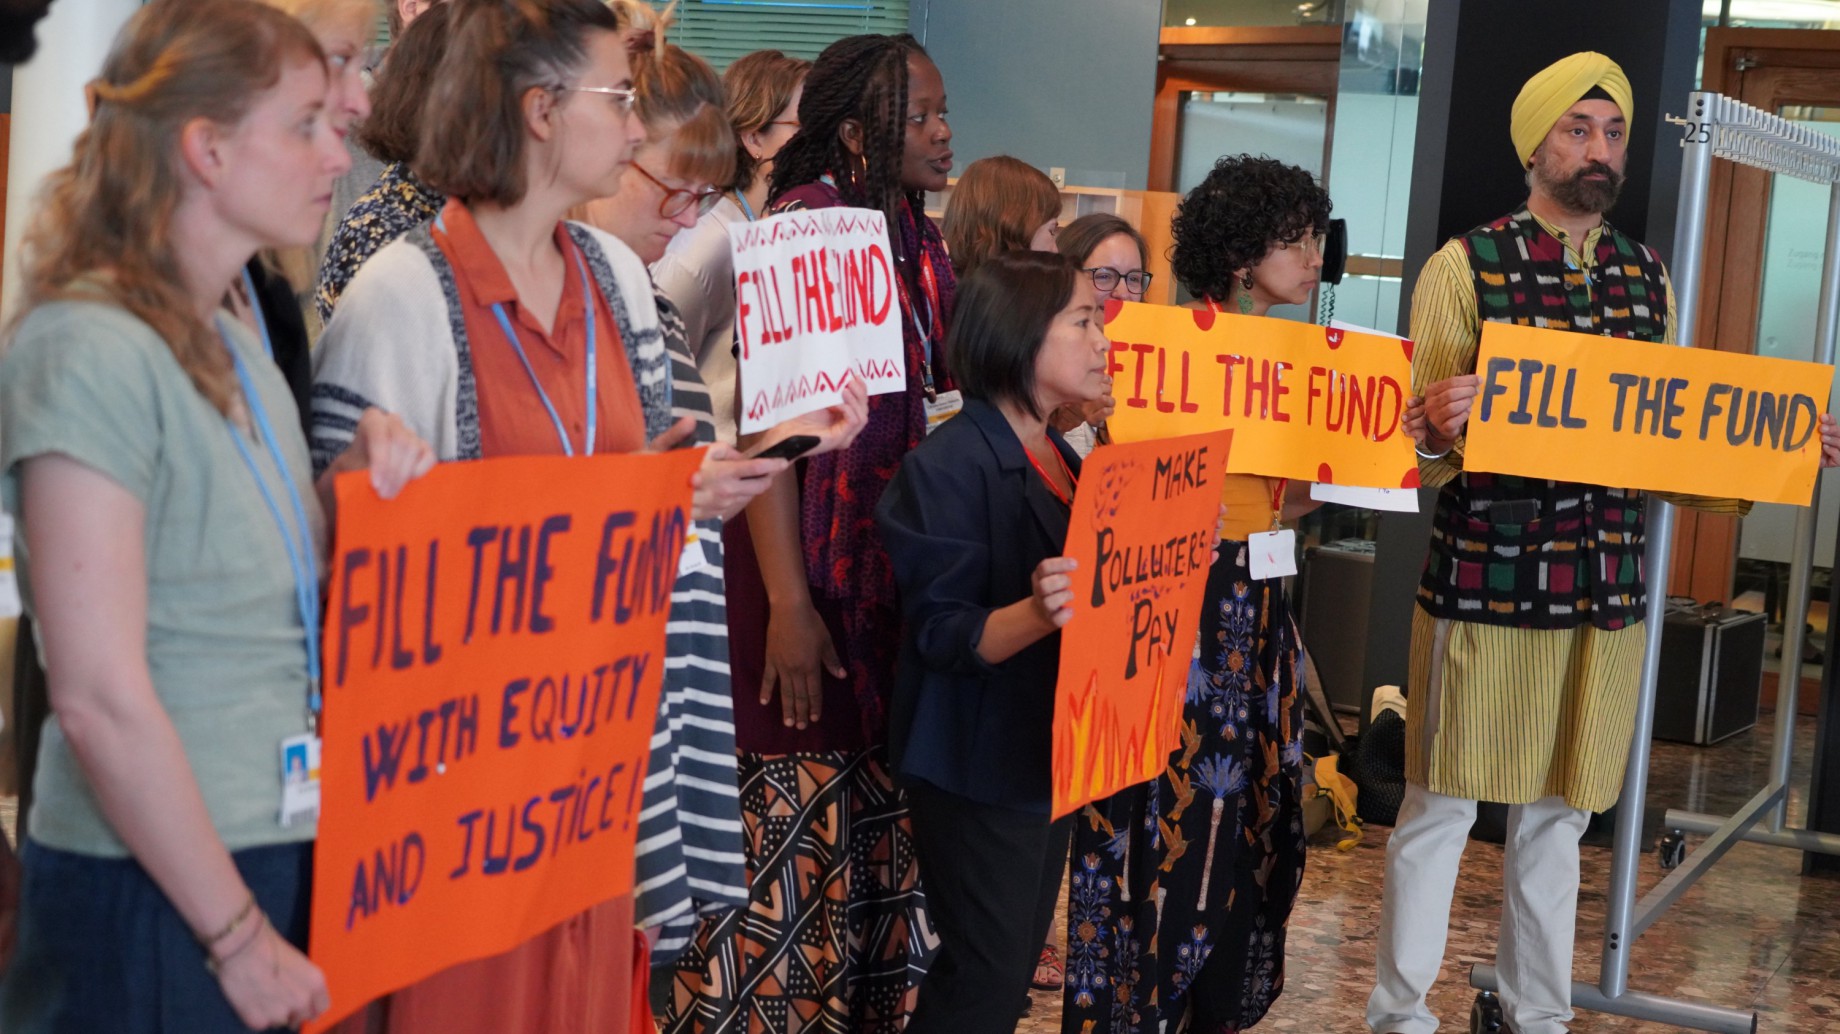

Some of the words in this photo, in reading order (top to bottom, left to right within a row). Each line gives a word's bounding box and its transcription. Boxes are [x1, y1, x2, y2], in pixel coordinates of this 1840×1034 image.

[1685, 122, 1711, 144] 25
[739, 264, 792, 360] FILL
[792, 246, 843, 334] THE
[1107, 340, 1199, 414] FILL
[1216, 353, 1293, 423] THE
[1307, 366, 1403, 443] FUND
[1480, 356, 1587, 429] FILL
[1609, 372, 1689, 440] THE
[1699, 382, 1818, 452] FUND
[1152, 445, 1208, 501] MAKE
[336, 537, 442, 688] FILL
[463, 513, 572, 645] THE
[591, 505, 686, 625] FUND
[1125, 598, 1179, 681] PAY
[362, 693, 478, 804] WITH
[498, 652, 649, 749] EQUITY
[346, 831, 426, 931] AND
